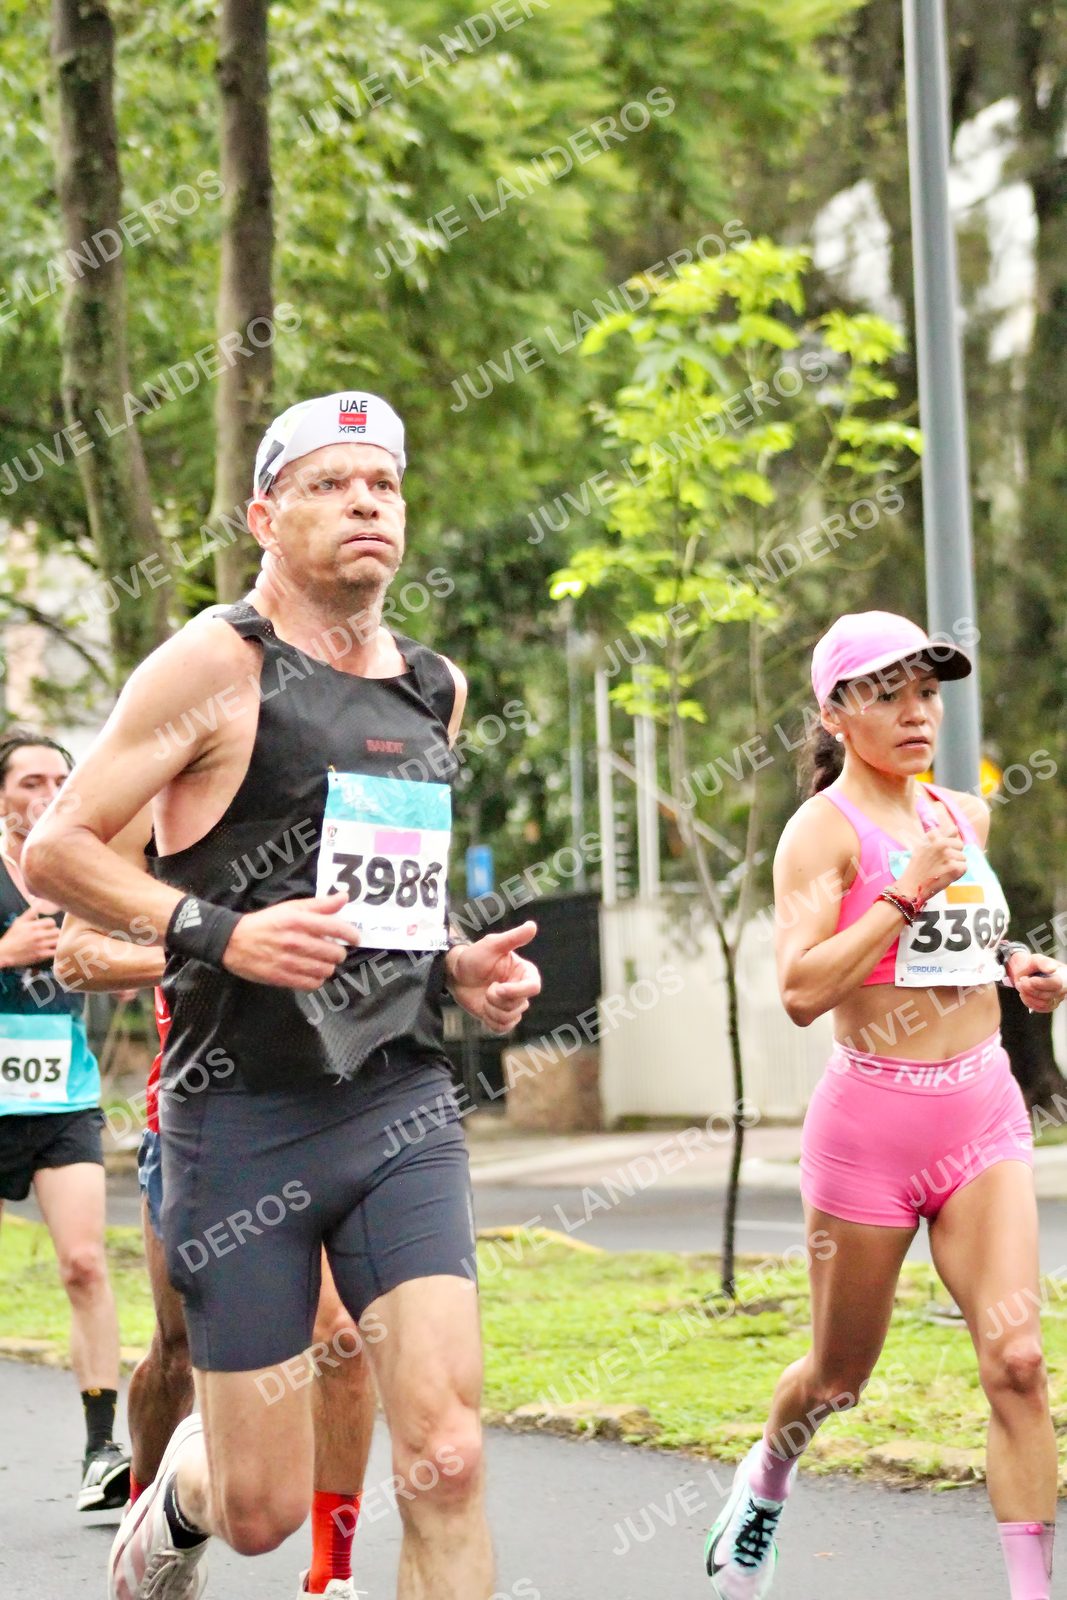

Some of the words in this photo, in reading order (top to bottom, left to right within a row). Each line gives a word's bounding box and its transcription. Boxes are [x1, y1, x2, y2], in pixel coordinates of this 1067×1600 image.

[339, 399, 368, 412] UAE
[339, 425, 366, 433] XRG
[326, 852, 443, 909] 3986
[909, 907, 1006, 954] 3369
[1, 1056, 62, 1084] 603
[893, 1055, 977, 1088] NIKE
